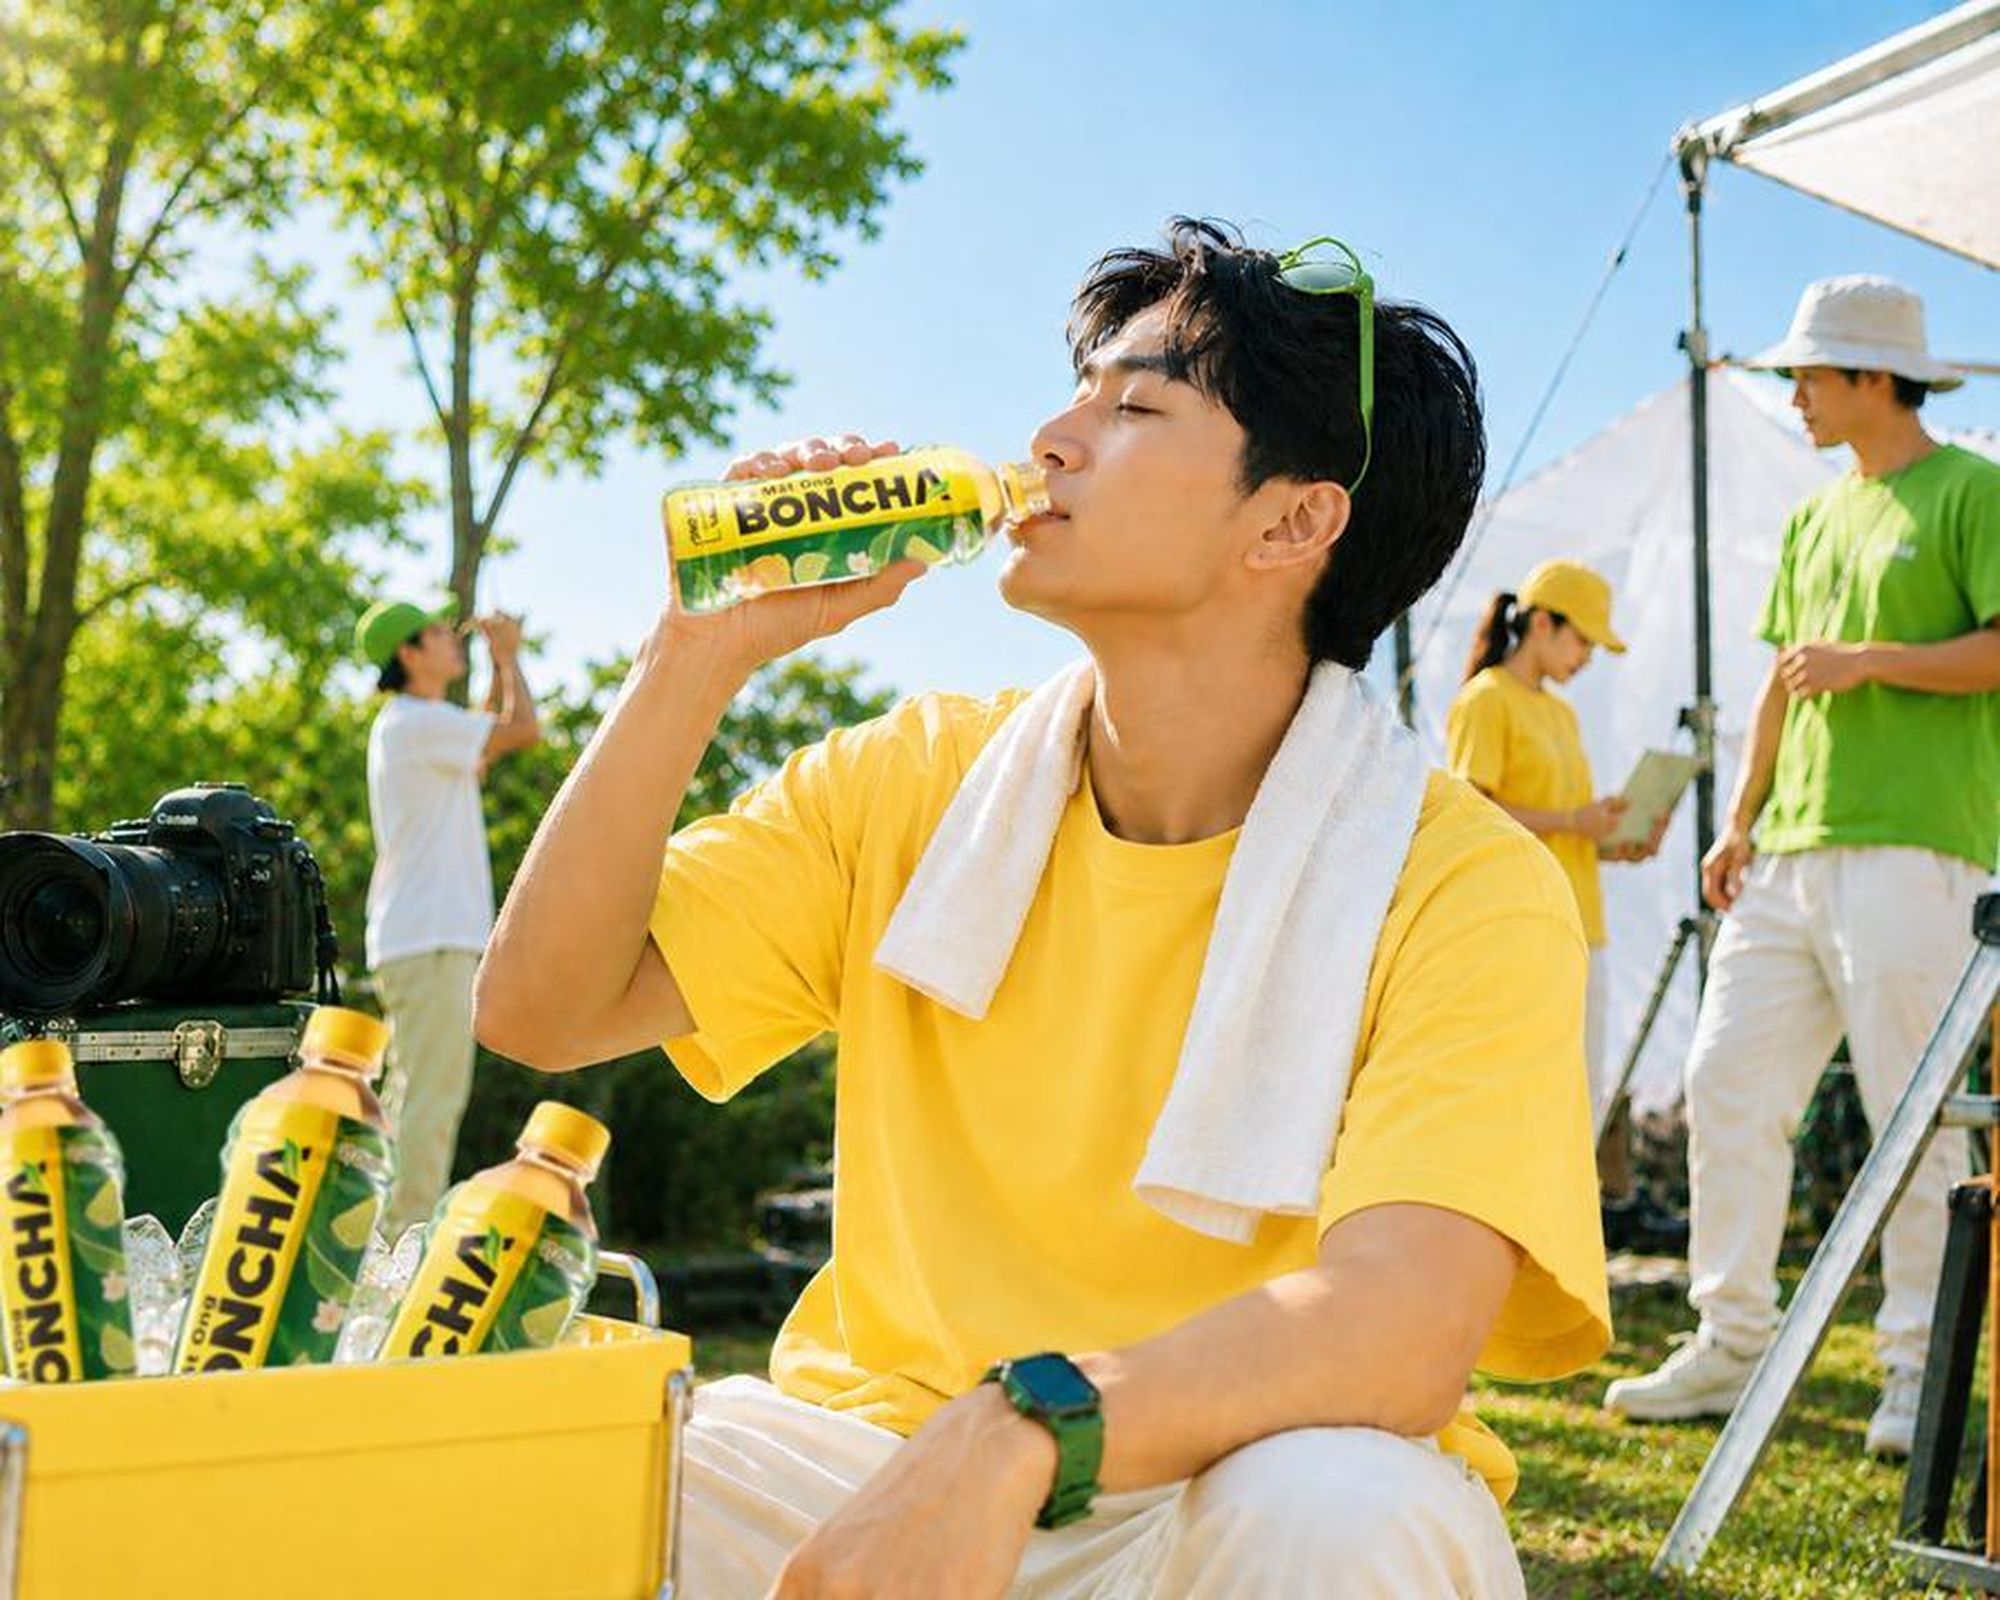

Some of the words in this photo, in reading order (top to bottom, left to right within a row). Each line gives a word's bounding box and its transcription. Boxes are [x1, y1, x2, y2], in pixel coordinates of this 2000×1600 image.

[735, 467, 951, 535] BONCHA
[7, 1161, 71, 1384] ONCHA
[201, 1147, 312, 1373] NCHA
[409, 1235, 515, 1358] CHA
